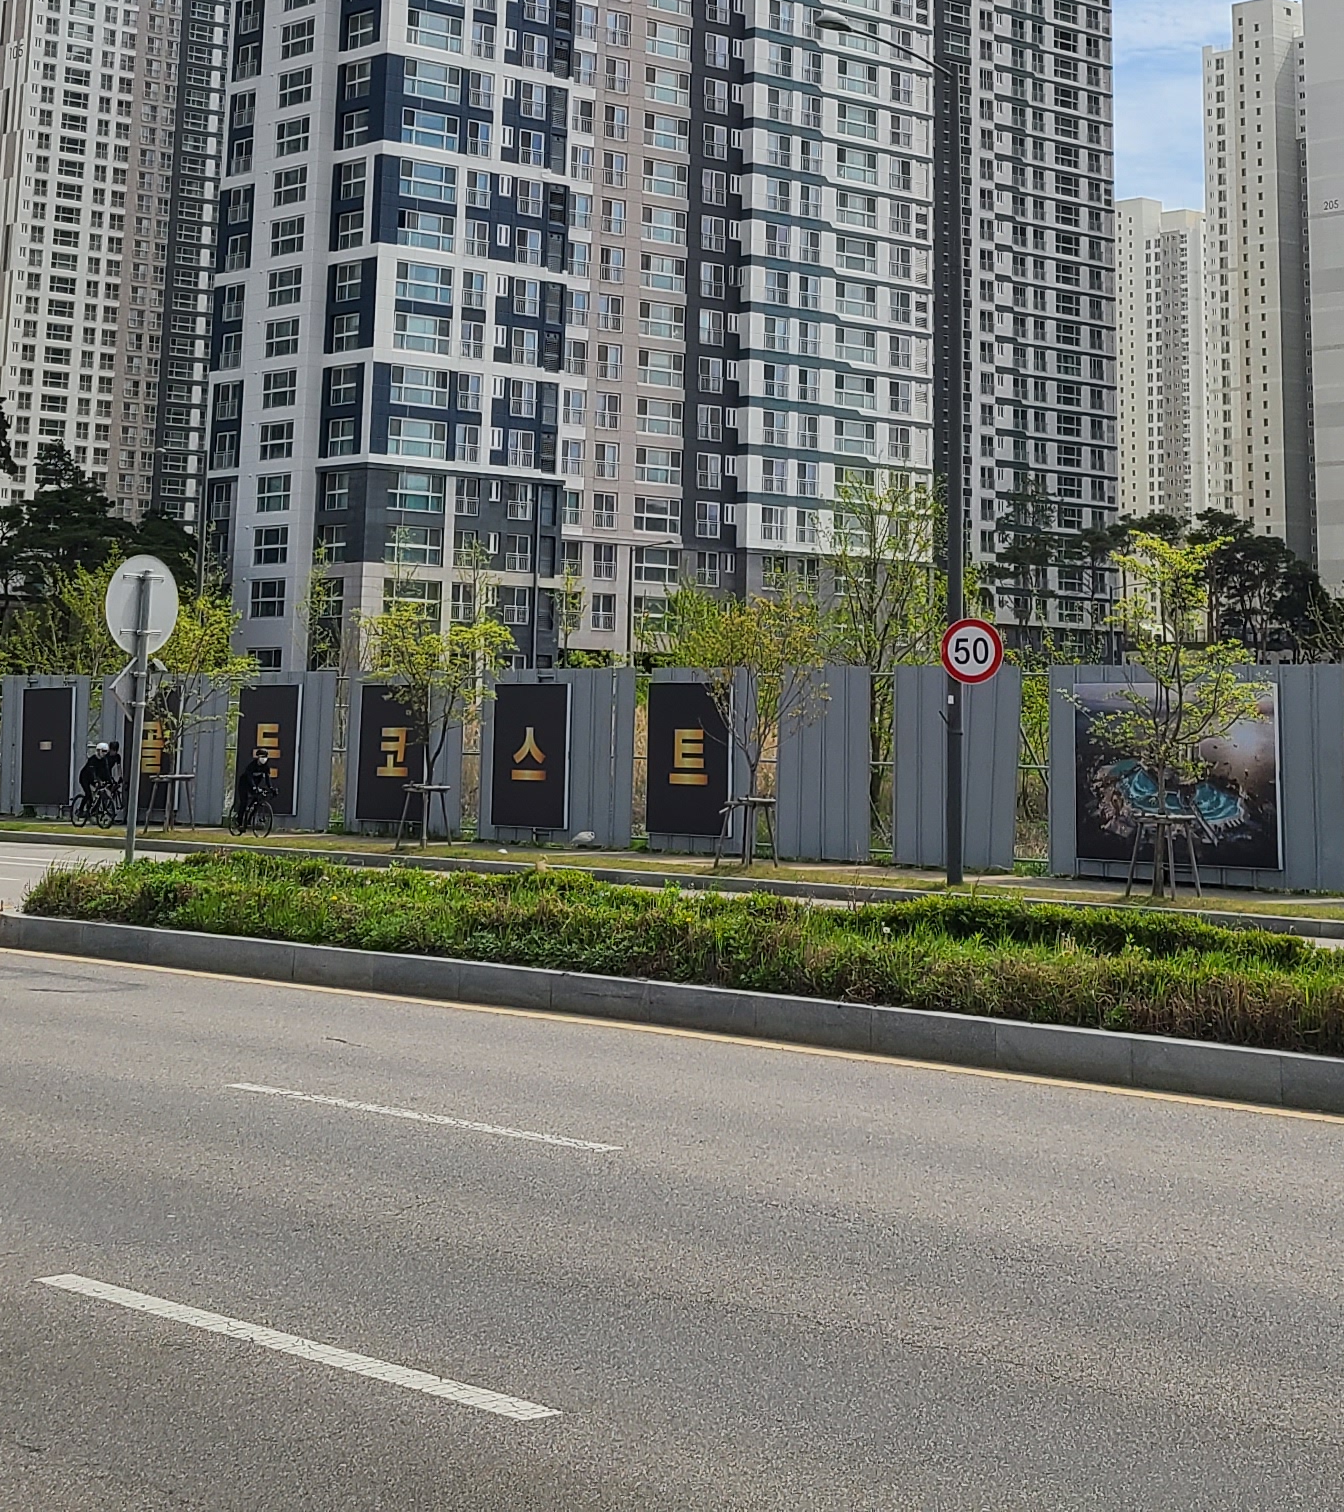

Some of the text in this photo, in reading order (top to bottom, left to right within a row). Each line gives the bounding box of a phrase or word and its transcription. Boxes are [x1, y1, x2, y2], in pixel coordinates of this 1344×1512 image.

[1323, 199, 1339, 211] 205
[954, 636, 990, 667] 50
[376, 726, 409, 778] 코
[510, 725, 547, 781] 스
[668, 728, 709, 786] 트
